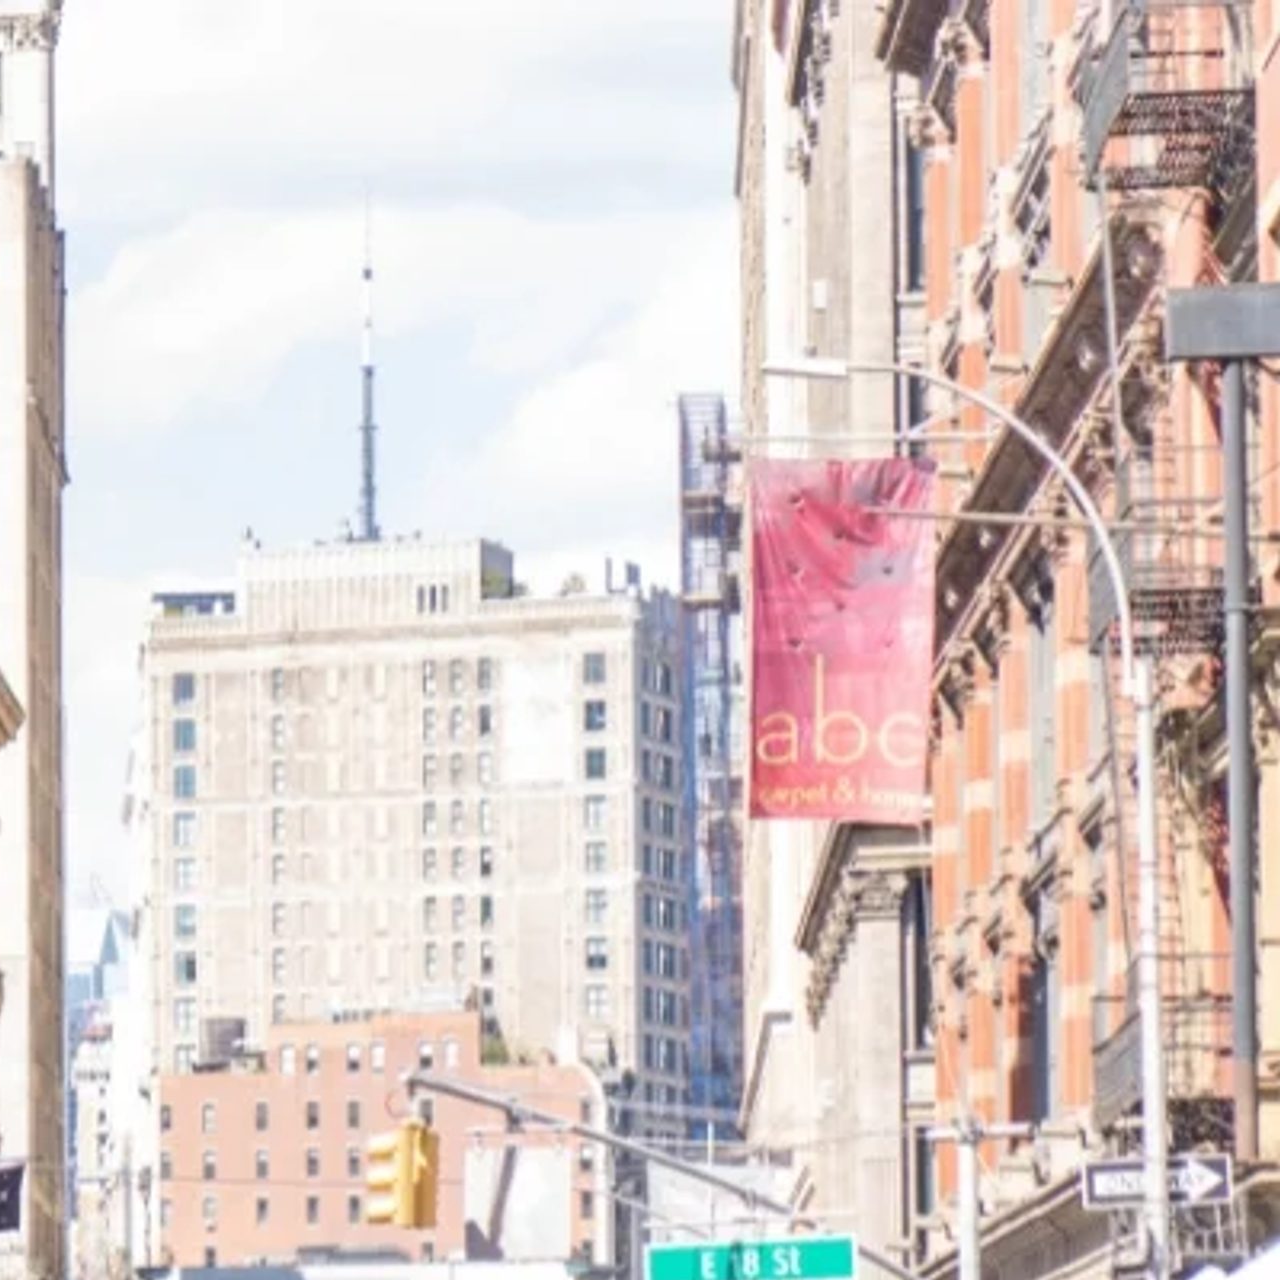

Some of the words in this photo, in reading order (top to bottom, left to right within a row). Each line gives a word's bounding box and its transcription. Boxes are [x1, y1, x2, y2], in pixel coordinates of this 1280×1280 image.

[756, 654, 921, 767] abc
[700, 1251, 717, 1280] E
[771, 1246, 801, 1276] St
